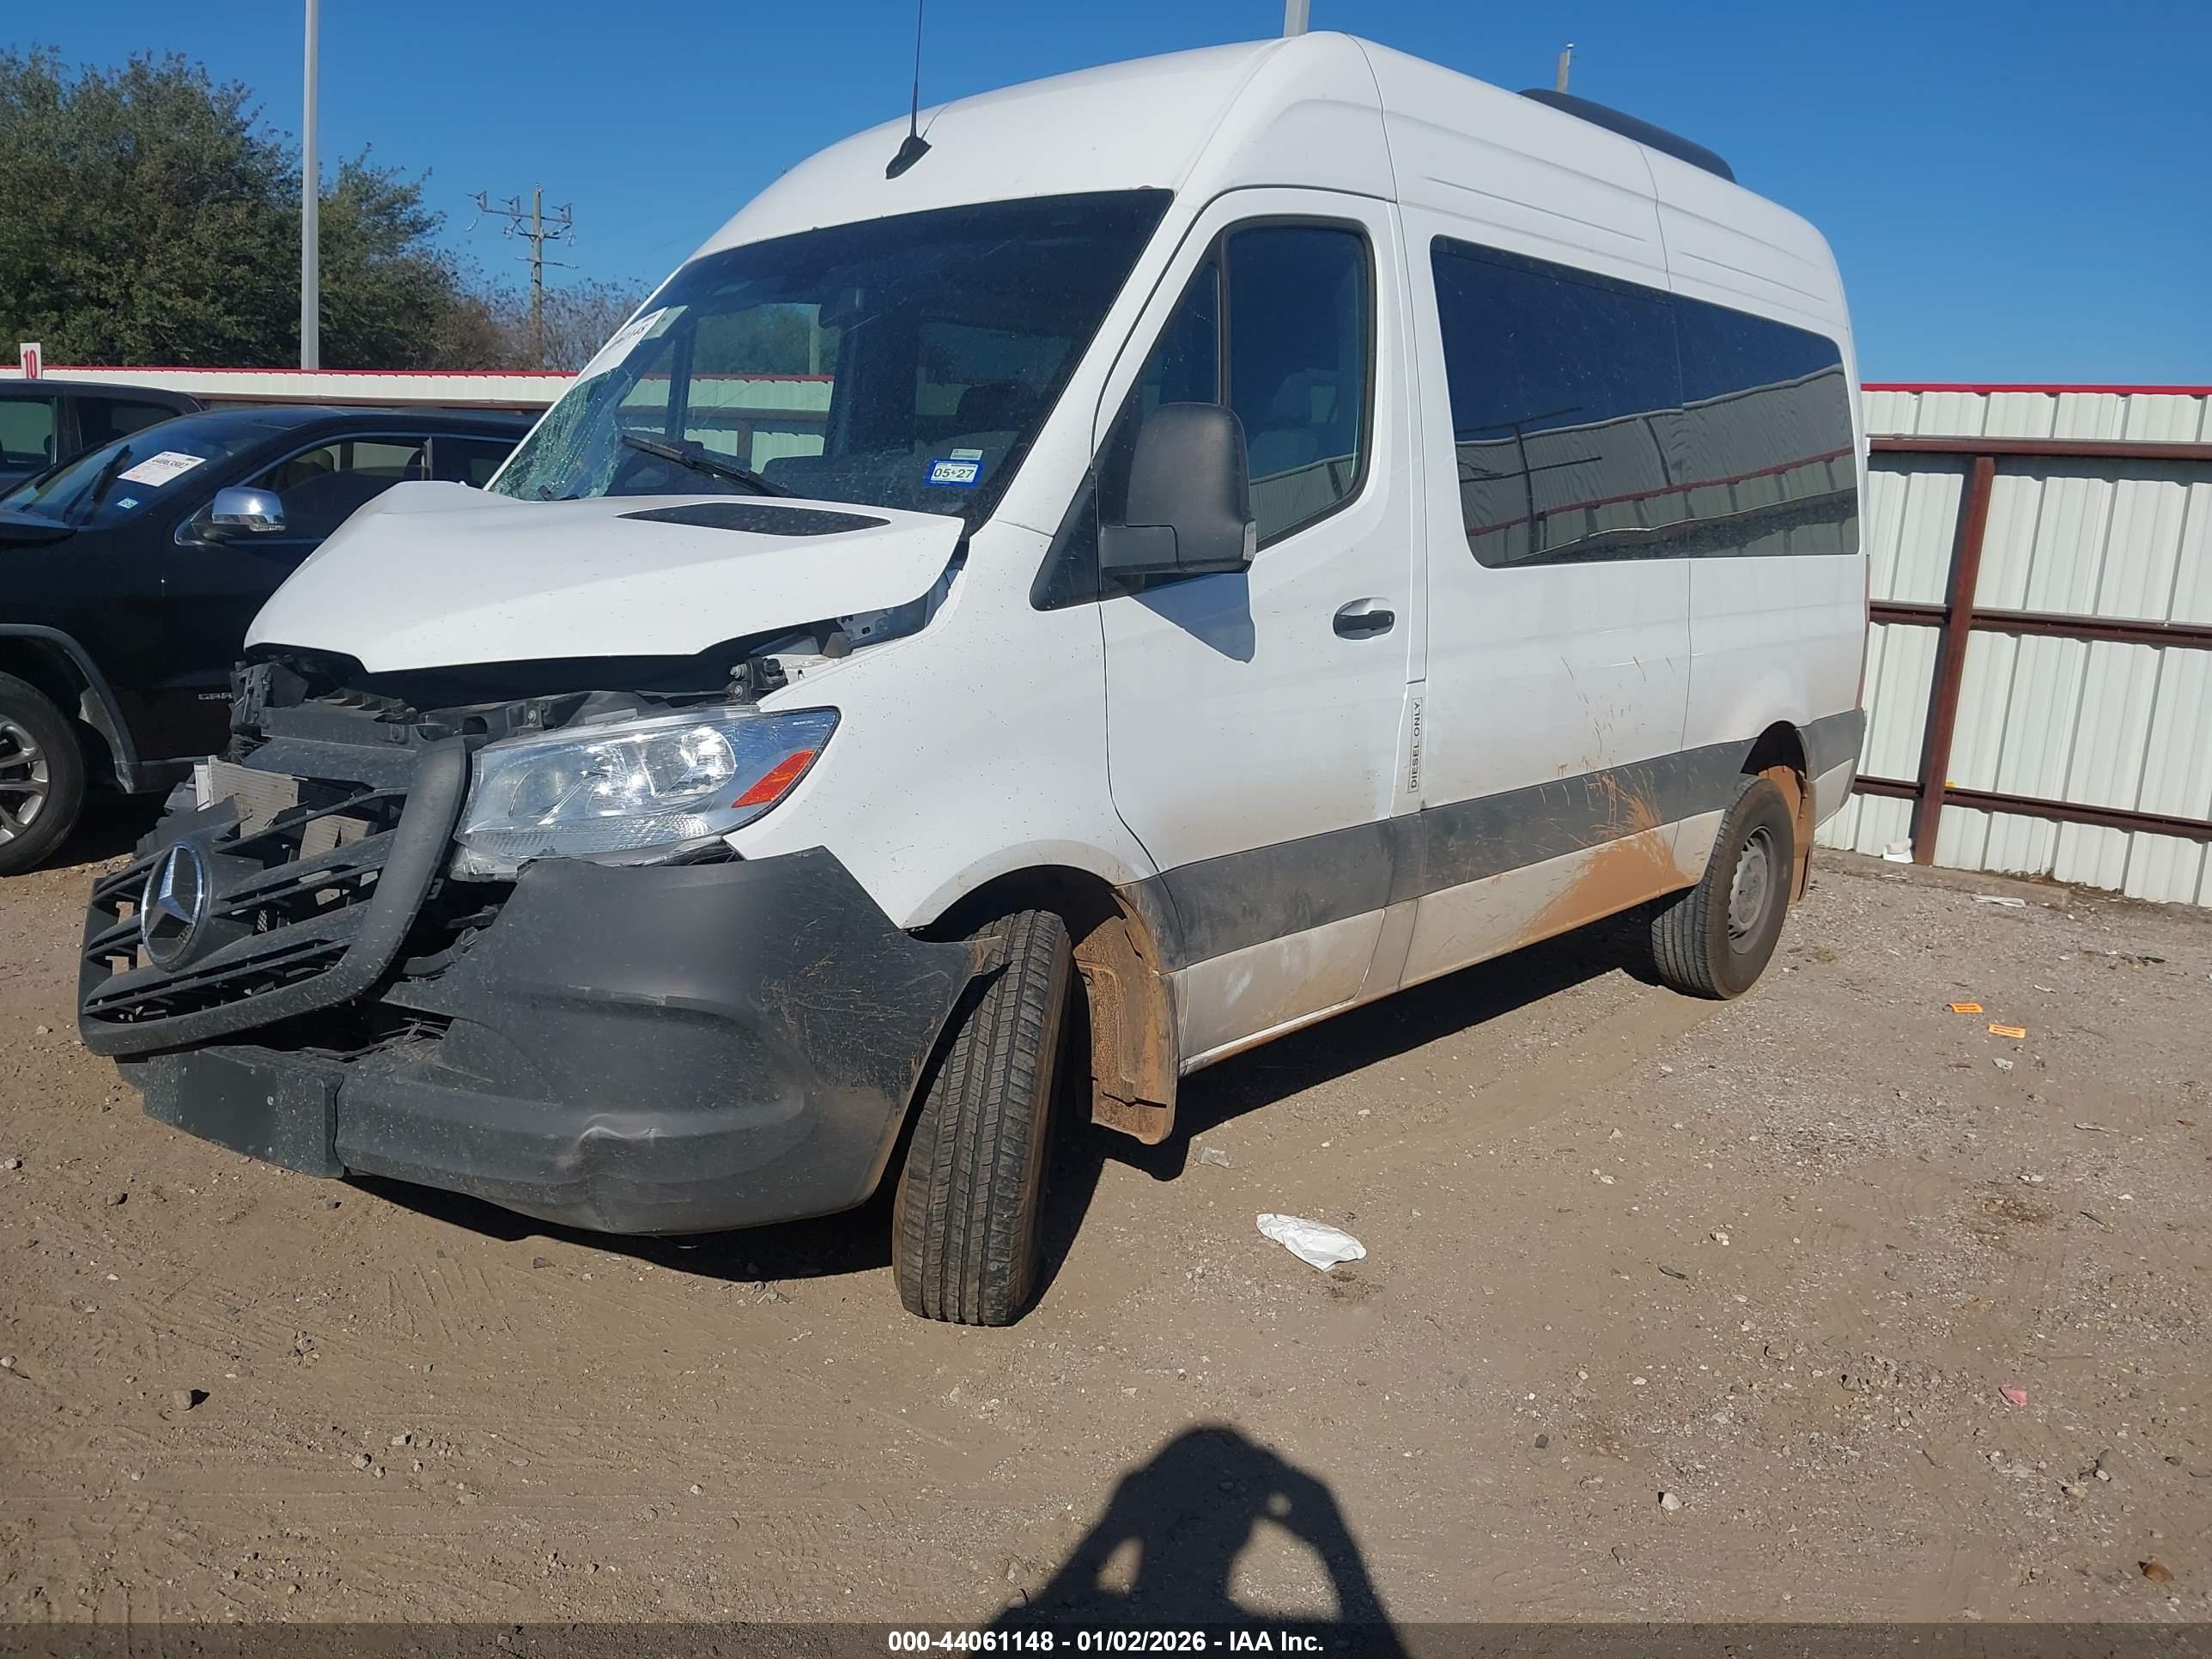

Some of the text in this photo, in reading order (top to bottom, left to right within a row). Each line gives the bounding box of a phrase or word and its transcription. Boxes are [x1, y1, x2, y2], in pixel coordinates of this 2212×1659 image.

[23, 349, 38, 379] 10
[933, 468, 975, 478] 05 27
[1410, 741, 1420, 788] DIESEL
